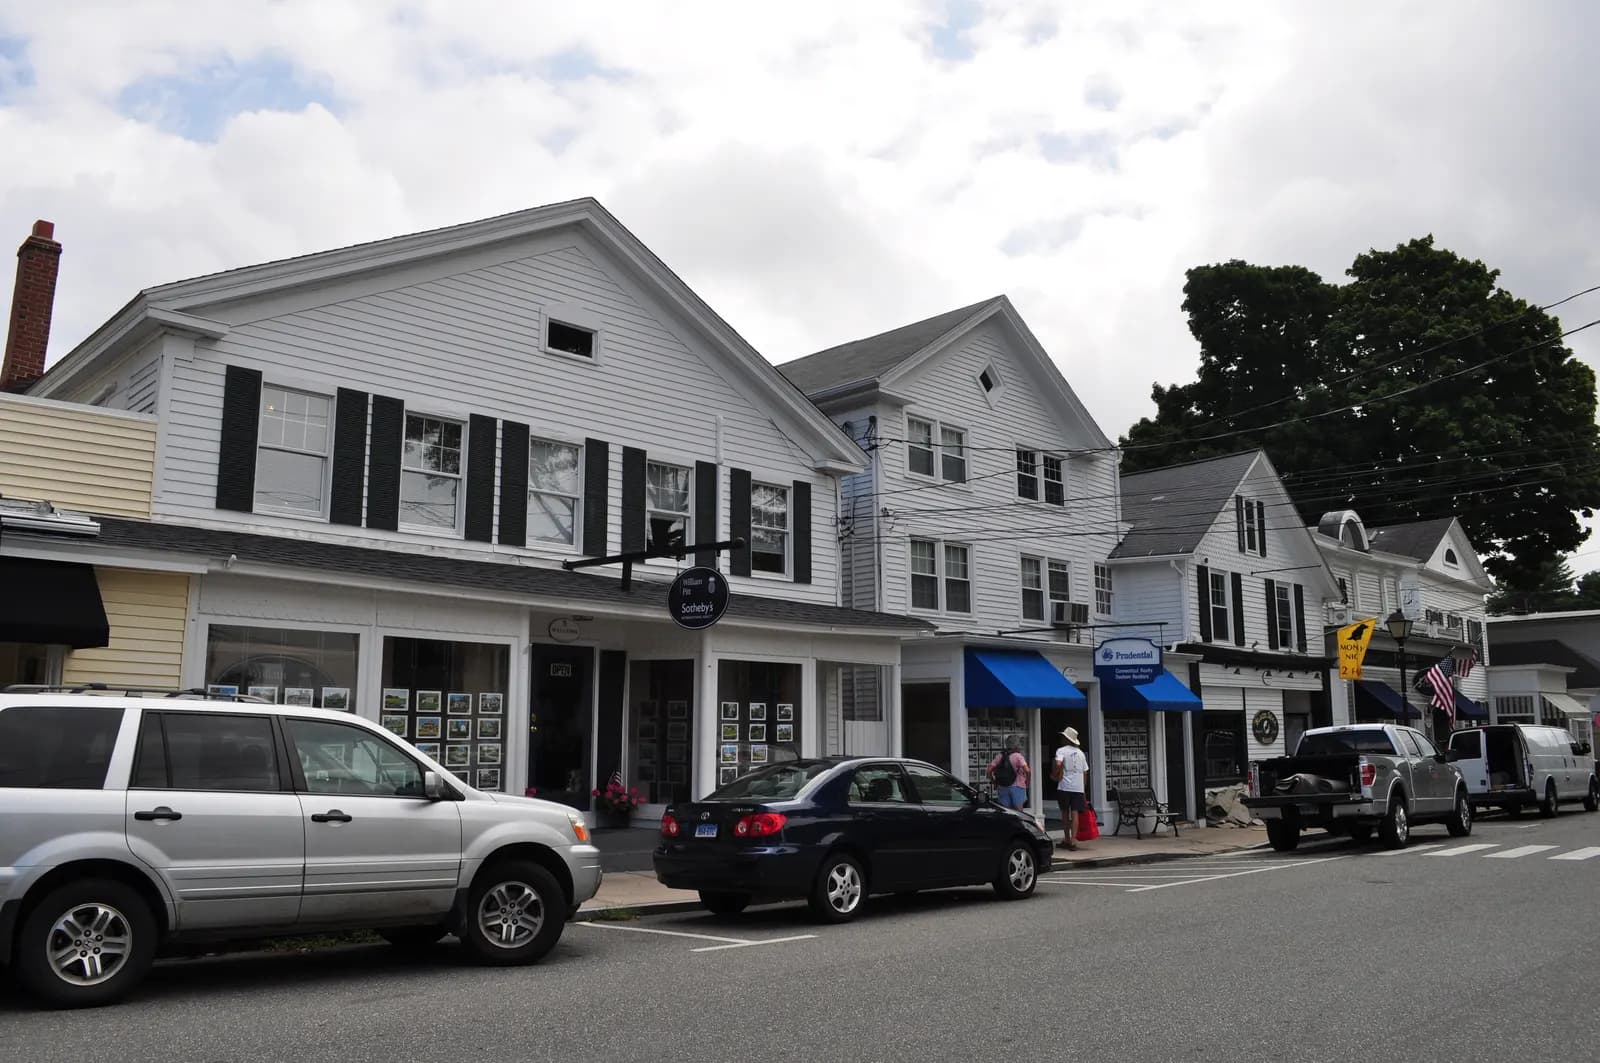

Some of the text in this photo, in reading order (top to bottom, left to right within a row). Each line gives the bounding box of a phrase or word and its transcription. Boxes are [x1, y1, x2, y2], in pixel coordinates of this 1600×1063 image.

[681, 602, 713, 615] Sotheby's
[1115, 651, 1153, 660] Prudential
[552, 664, 570, 677] OPEN
[1341, 666, 1348, 675] 2
